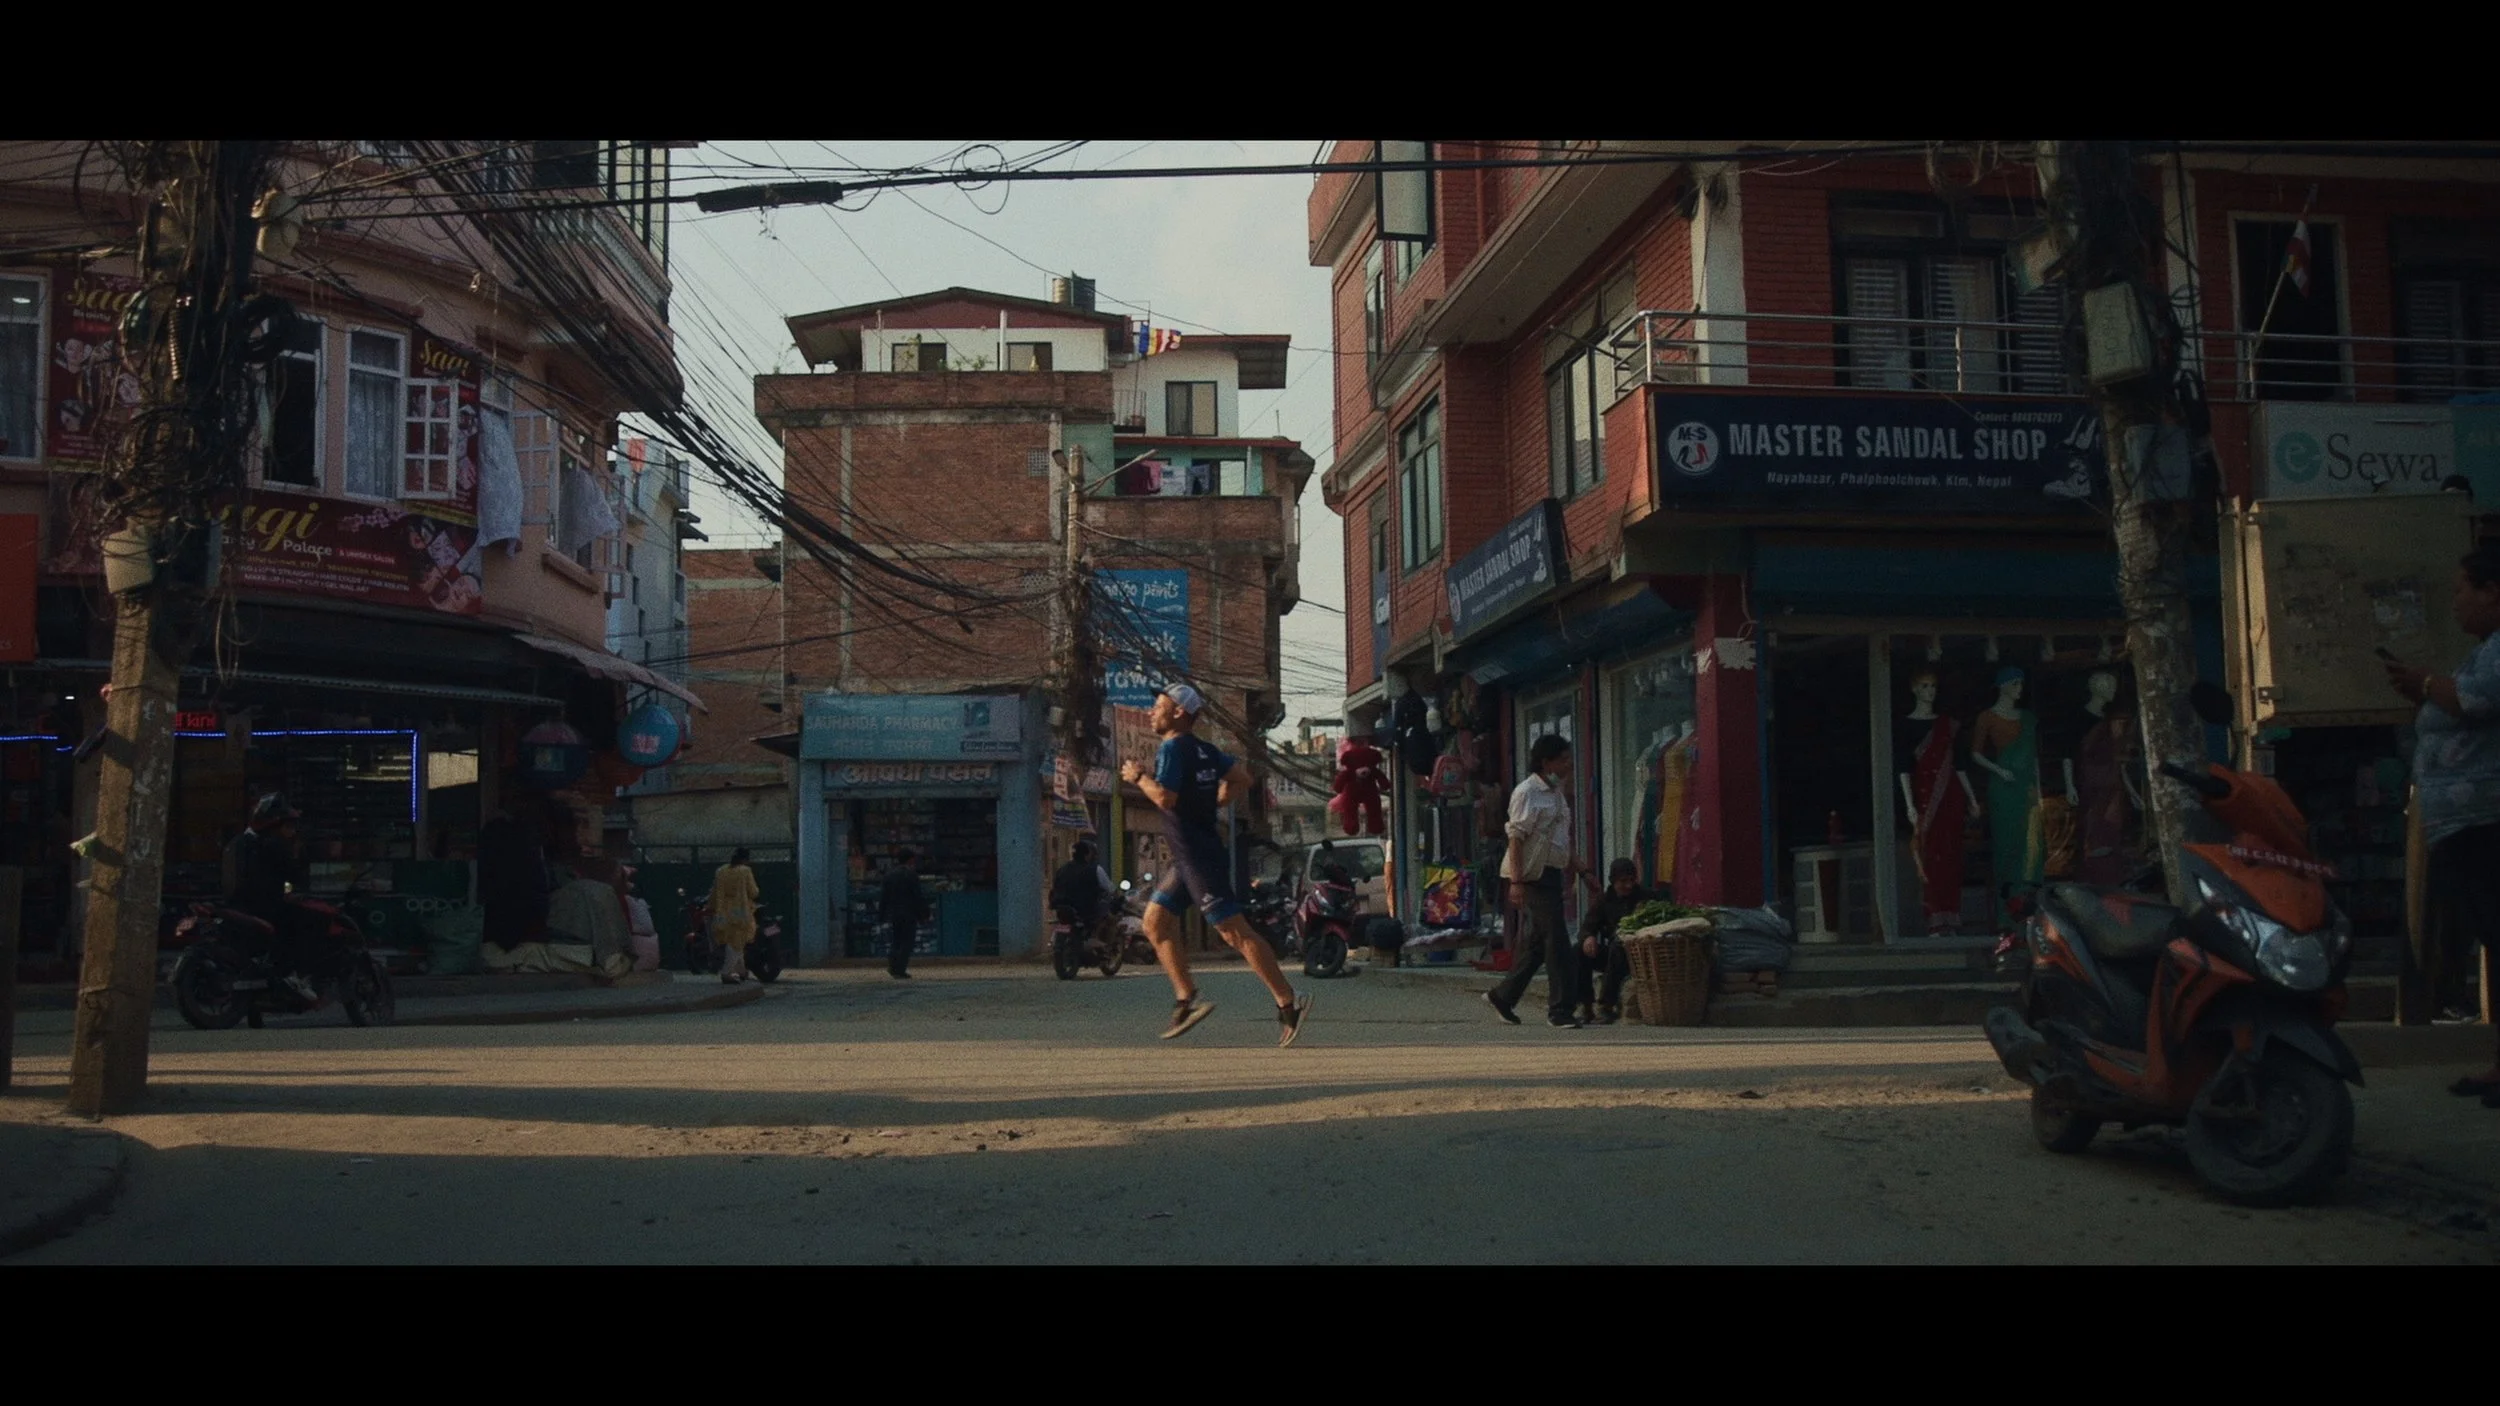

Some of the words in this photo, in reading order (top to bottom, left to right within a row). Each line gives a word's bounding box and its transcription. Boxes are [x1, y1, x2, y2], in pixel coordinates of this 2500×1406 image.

[1728, 423, 1844, 457] MASTER
[1856, 425, 1964, 460] SANDAL
[1973, 427, 2048, 461] SHOP
[1977, 474, 2012, 488] Nepal
[283, 539, 333, 562] Palace
[1509, 534, 1531, 567] SHOP
[884, 715, 958, 731] PHARMACY
